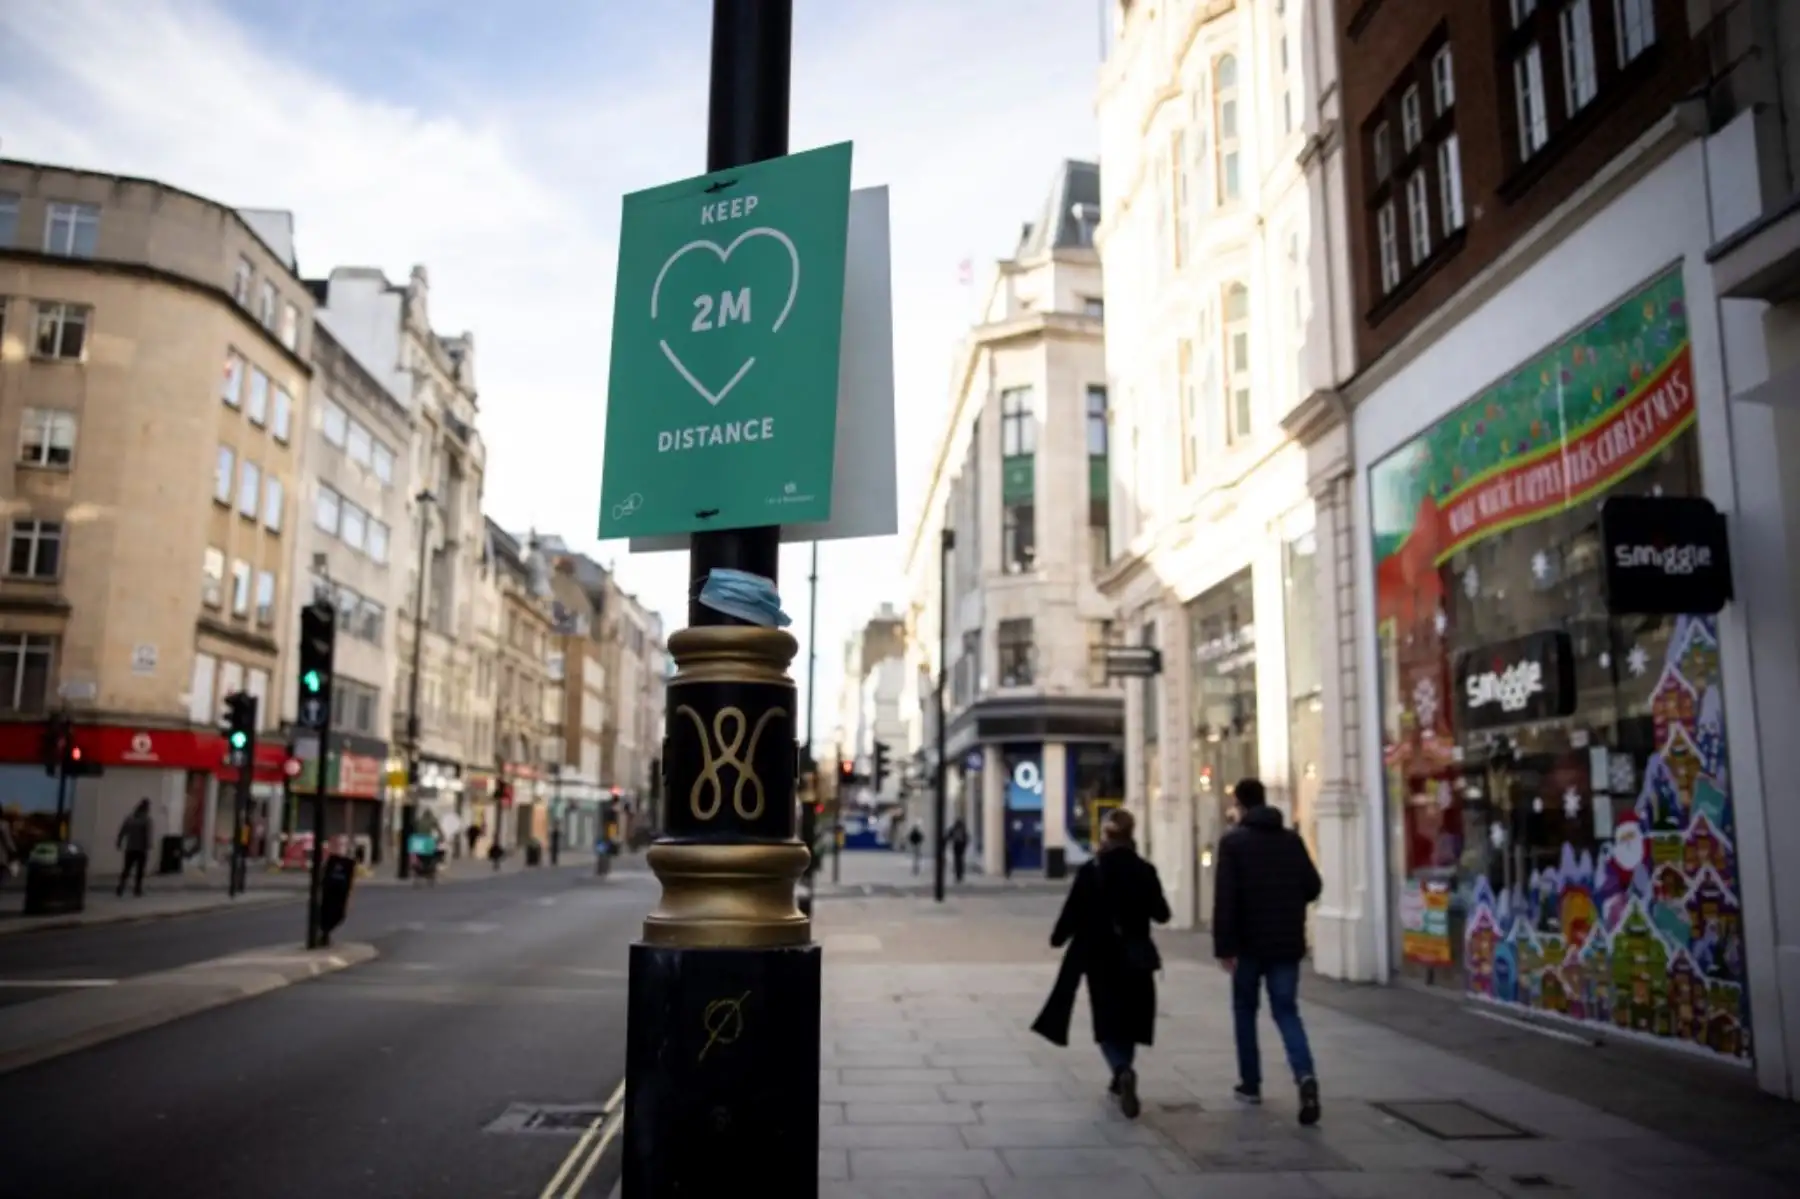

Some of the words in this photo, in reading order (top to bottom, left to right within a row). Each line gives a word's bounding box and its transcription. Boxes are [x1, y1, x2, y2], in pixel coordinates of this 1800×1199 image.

[701, 195, 758, 225] KEEP
[691, 287, 751, 332] 2M
[658, 416, 774, 452] DISTANCE
[1597, 368, 1689, 468] CHRISTMAS
